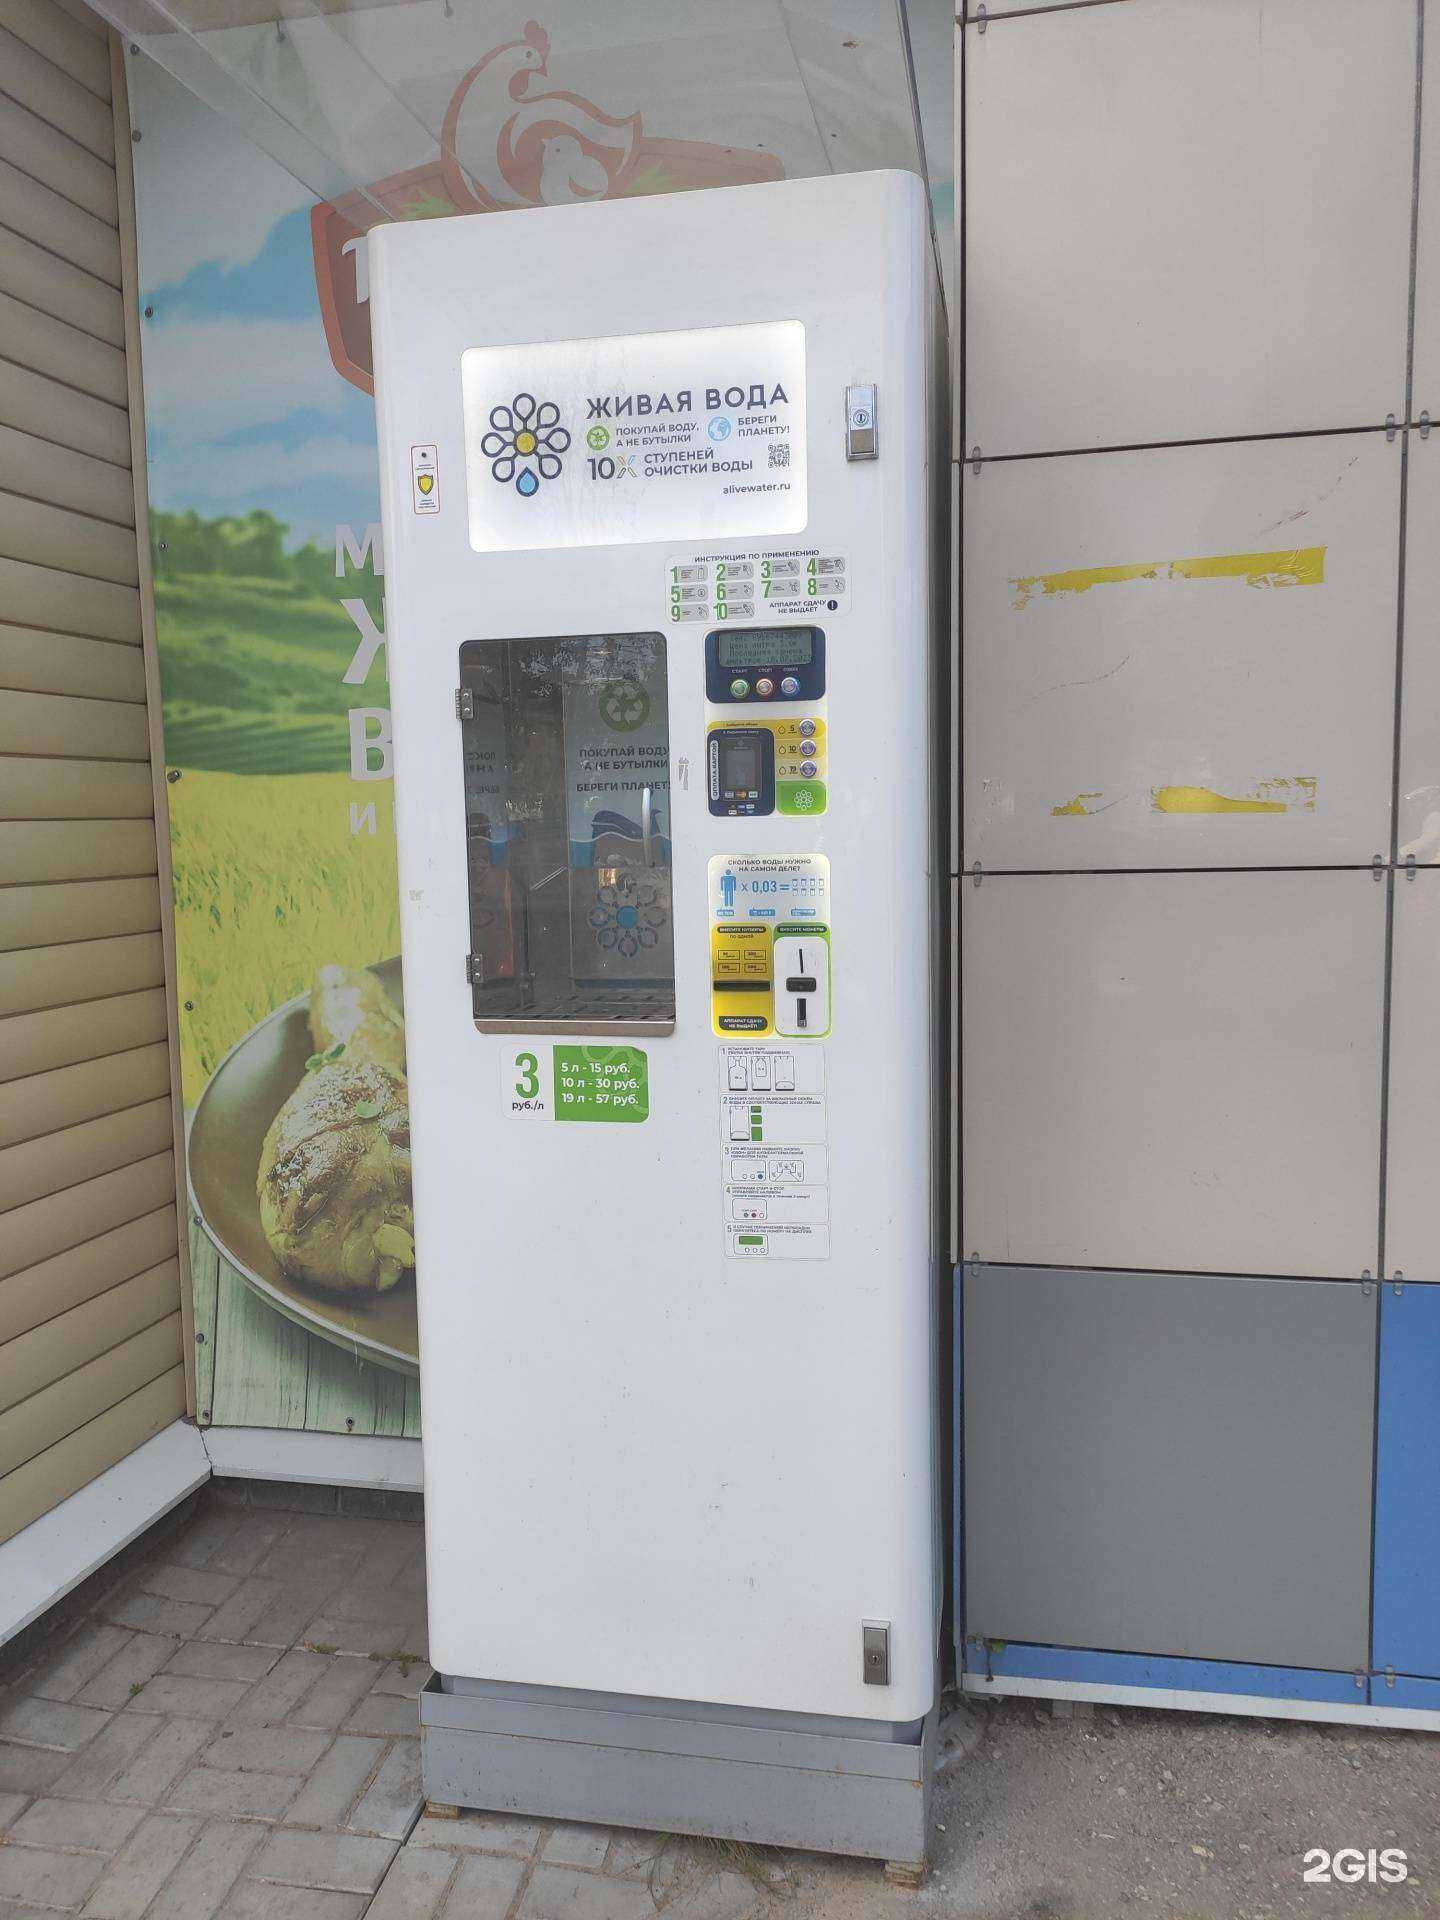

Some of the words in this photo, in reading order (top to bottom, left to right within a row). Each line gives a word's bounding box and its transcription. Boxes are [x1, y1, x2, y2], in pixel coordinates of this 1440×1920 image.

[586, 390, 692, 420] ЖИВАЯ
[705, 383, 789, 410] ВОДА
[737, 415, 777, 426] БЕРЕГИ
[616, 424, 666, 436] ПОКУПАЙ
[669, 422, 700, 433] ВОДУ,
[737, 425, 790, 437] ПЛАНЕТУ!
[616, 438, 624, 447] А
[626, 437, 640, 447] НЕ
[642, 434, 691, 446] БУТЫЛКИ
[644, 448, 714, 464] СТУПЕНЕЙ
[644, 464, 709, 478] ОЧИСТКИ
[712, 460, 753, 473] ВОДЫ
[723, 482, 791, 495] alivewater.ru
[695, 554, 746, 563] ИНСТРУКЦИЯ
[762, 550, 819, 559] ПРИМЕНЕНИЮ
[670, 566, 679, 583] 1
[716, 563, 726, 581] 2
[761, 561, 771, 578] 3
[806, 558, 817, 576] 4
[671, 586, 680, 603] 5
[716, 583, 726, 601] 6
[761, 581, 772, 598] 7
[808, 578, 817, 596] 8
[713, 603, 728, 620] 10
[770, 601, 801, 609] АППАРАТ
[671, 605, 681, 622] 9
[579, 749, 635, 758] ПОКУПАЙ
[614, 760, 668, 770] БУТЫЛКИ
[576, 782, 618, 792] БЕРЕГИ
[516, 1052, 539, 1099] 3
[561, 1063, 568, 1072] 5
[589, 1063, 601, 1073] 15
[605, 1063, 630, 1075] руб.
[561, 1078, 574, 1088] 10
[577, 1080, 584, 1088] л
[596, 1079, 610, 1088] 30
[614, 1079, 639, 1090] руб.
[512, 1101, 544, 1111] руб./л
[562, 1093, 574, 1103] 19
[596, 1094, 610, 1103] 57
[614, 1094, 639, 1106] руб.
